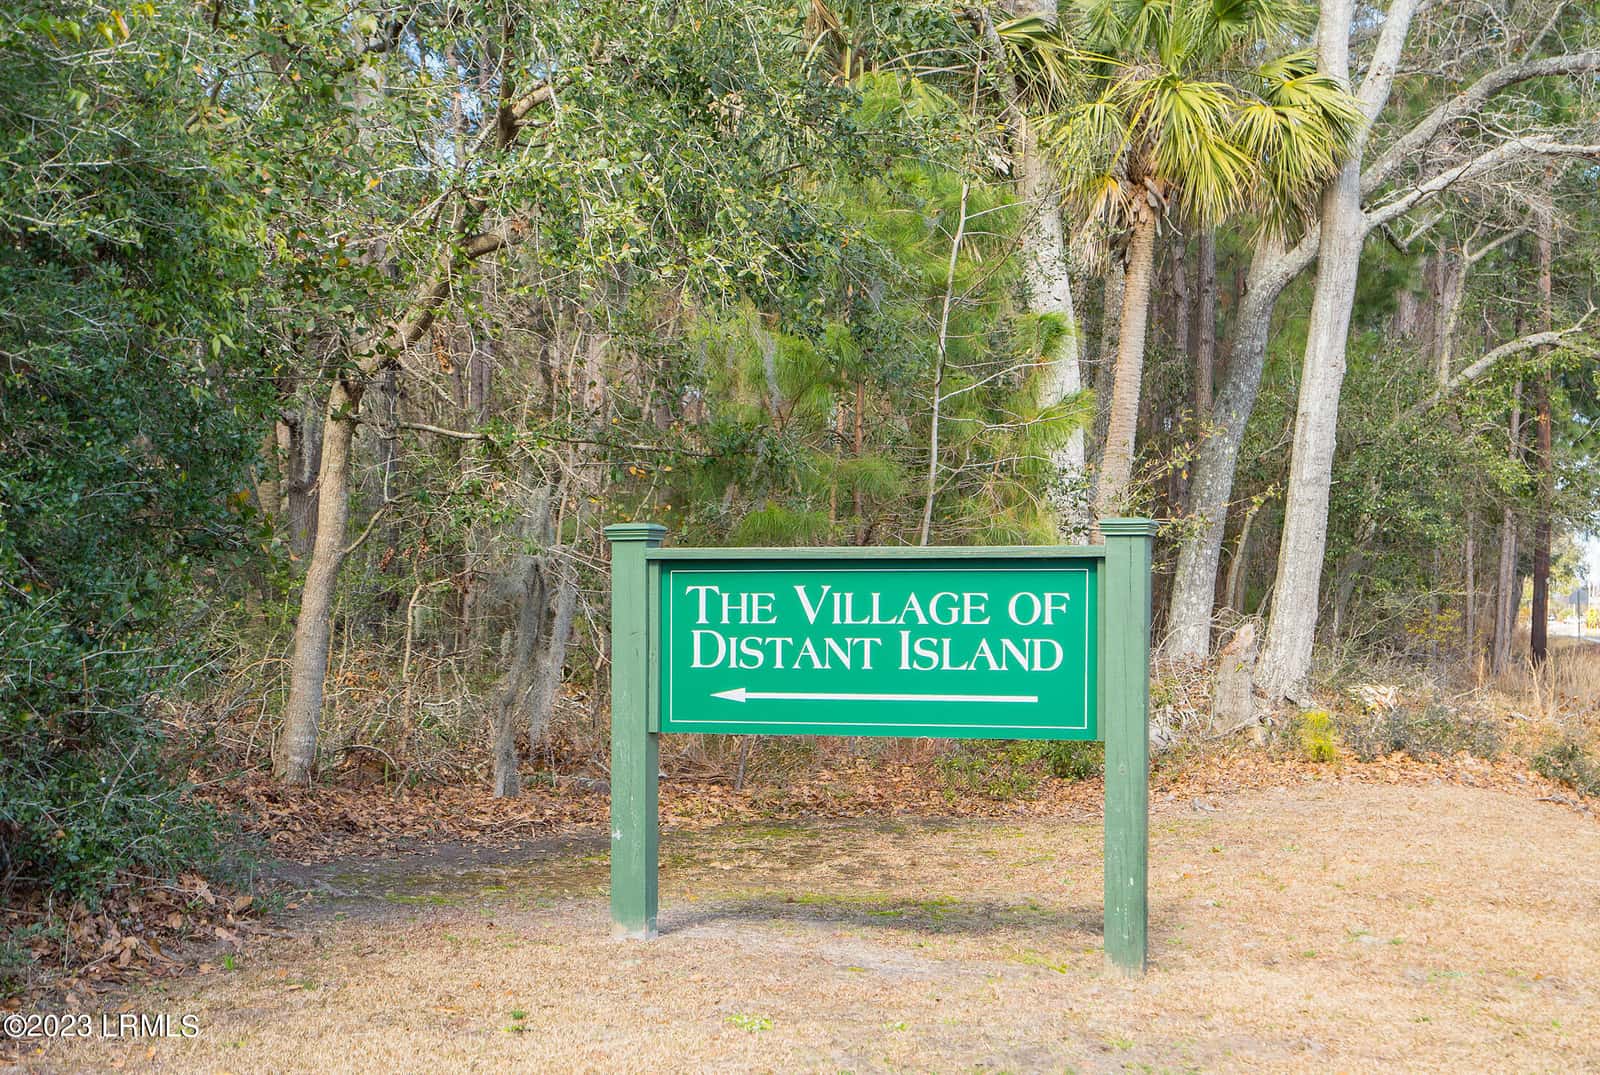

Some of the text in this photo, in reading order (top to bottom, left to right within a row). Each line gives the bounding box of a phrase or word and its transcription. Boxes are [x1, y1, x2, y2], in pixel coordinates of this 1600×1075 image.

[685, 585, 1071, 626] THE VILLAGE OF
[690, 629, 1065, 673] DISTANT ISLAND
